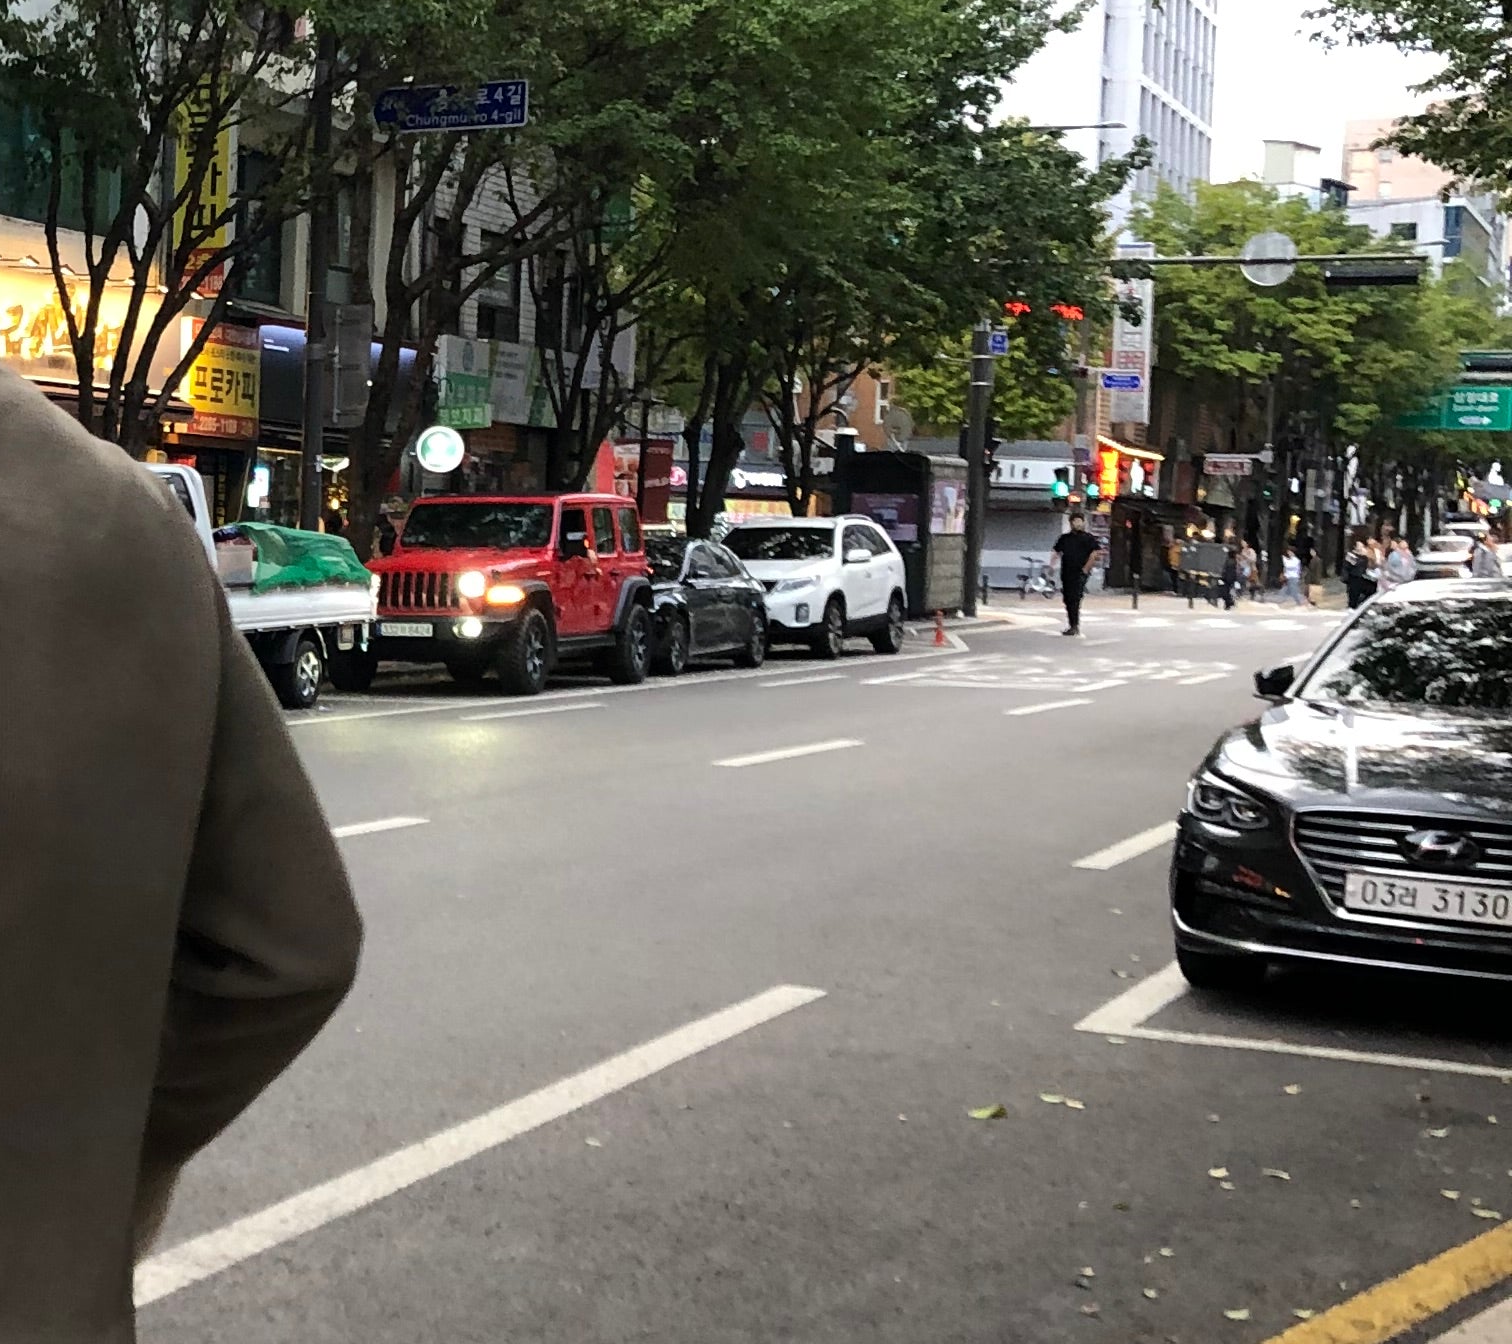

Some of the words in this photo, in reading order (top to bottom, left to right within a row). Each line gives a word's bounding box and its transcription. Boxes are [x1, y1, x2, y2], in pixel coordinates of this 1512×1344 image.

[406, 114, 488, 128] Chungmuro
[194, 365, 256, 408] 프로카피
[1432, 887, 1510, 920] 3130
